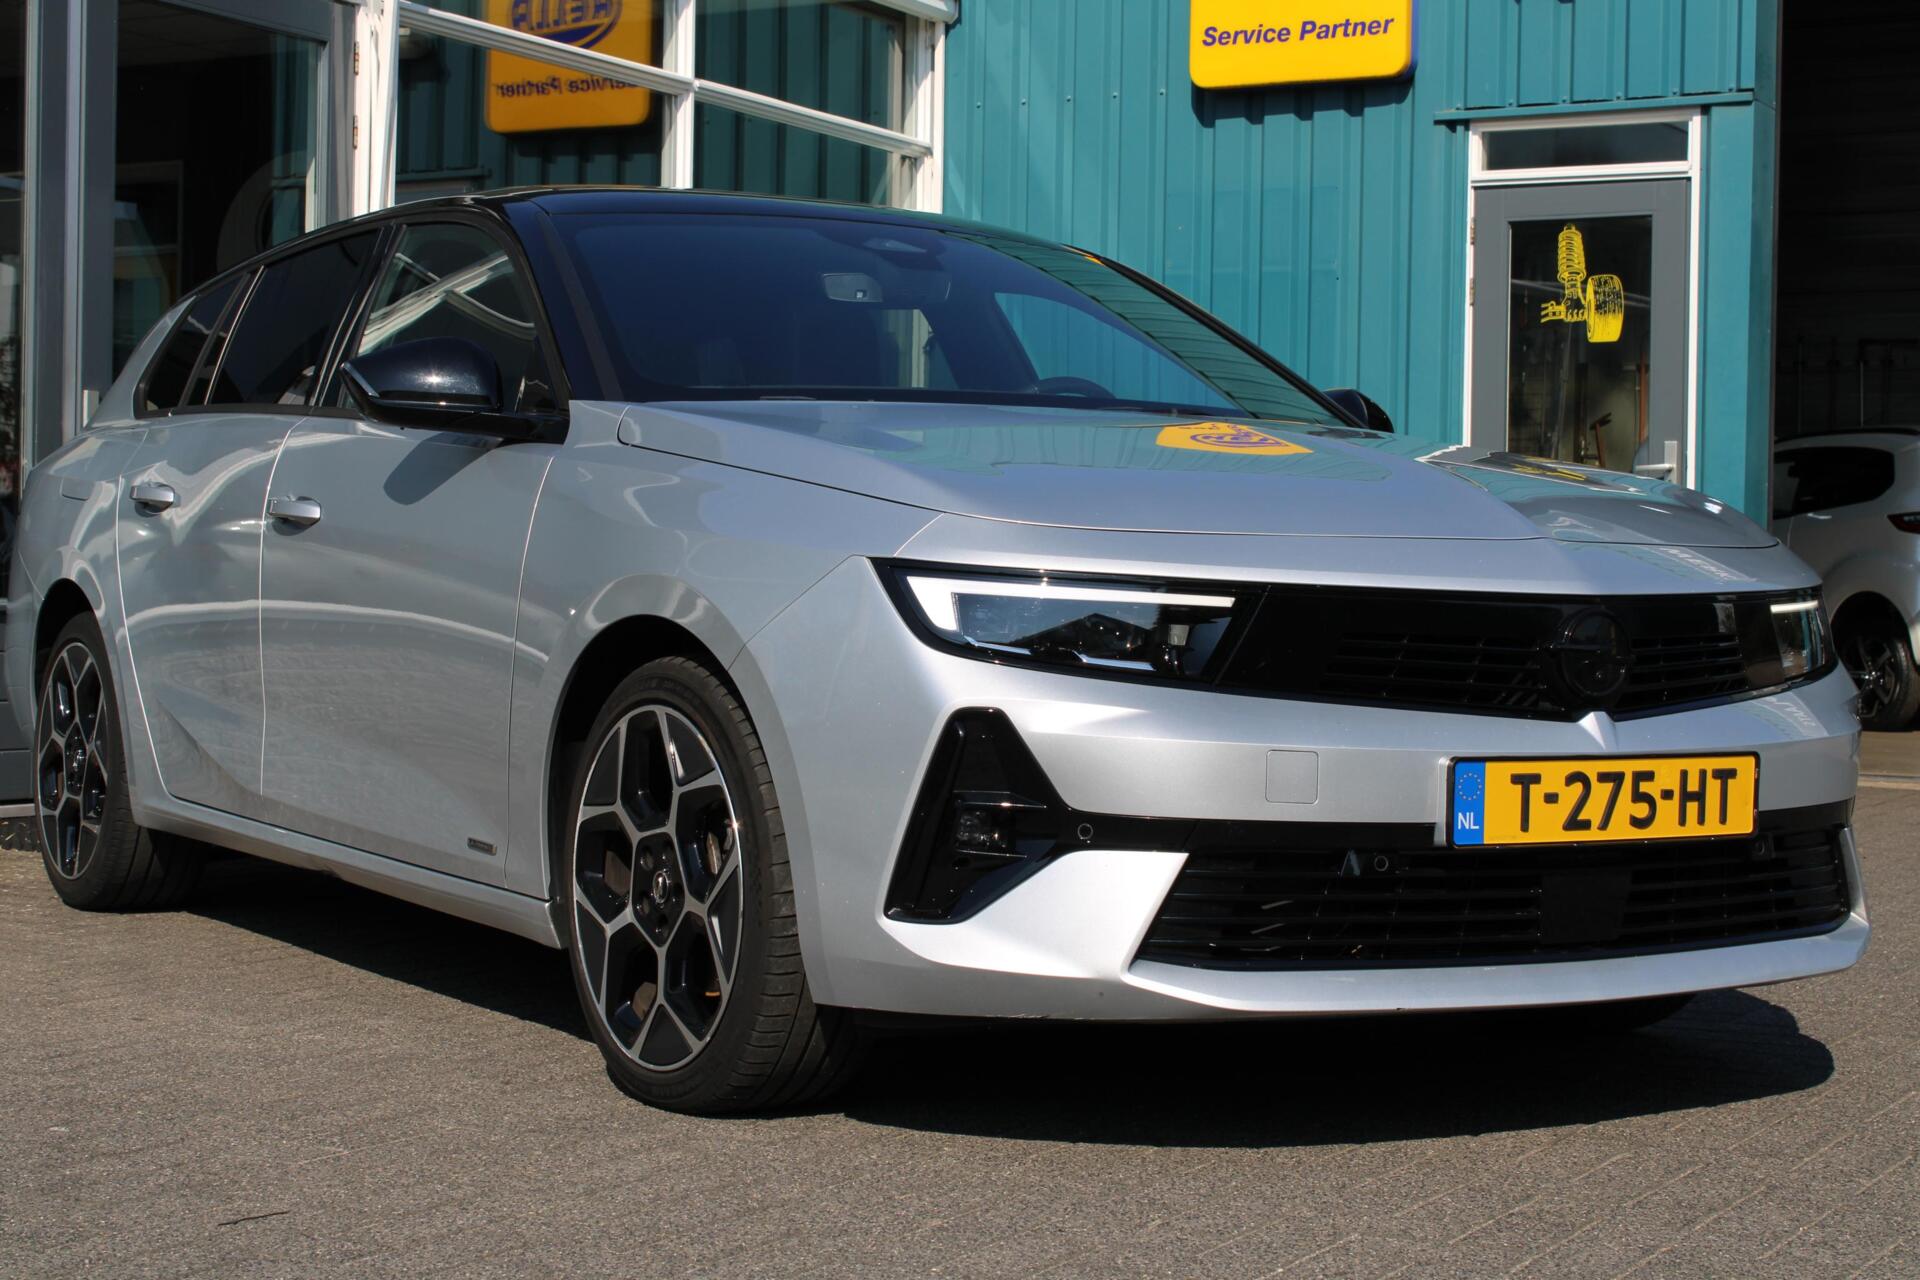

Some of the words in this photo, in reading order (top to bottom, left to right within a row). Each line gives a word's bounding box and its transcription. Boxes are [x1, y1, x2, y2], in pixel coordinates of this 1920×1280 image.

[1202, 23, 1291, 47] Service
[1299, 18, 1395, 41] Partner
[1510, 767, 1738, 833] T-275-HT
[1457, 811, 1480, 830] NL
